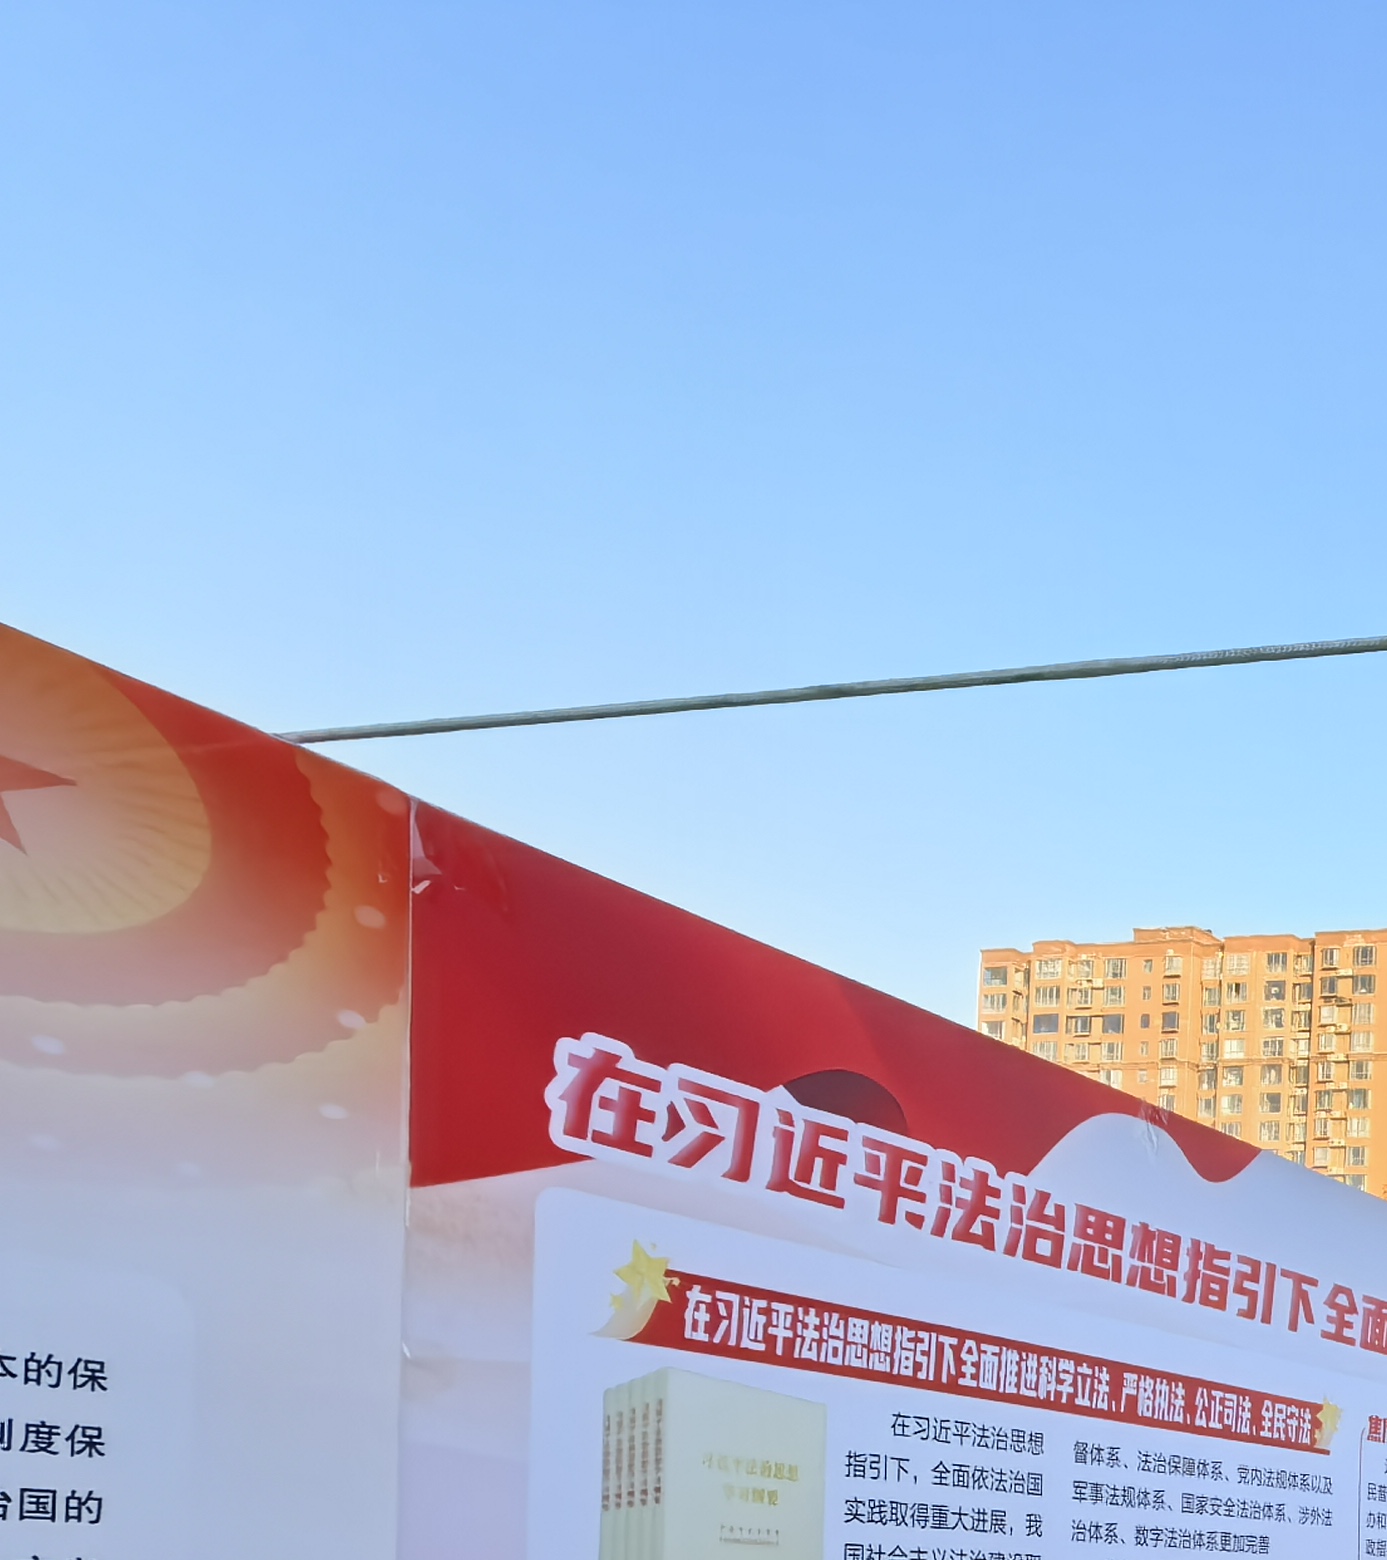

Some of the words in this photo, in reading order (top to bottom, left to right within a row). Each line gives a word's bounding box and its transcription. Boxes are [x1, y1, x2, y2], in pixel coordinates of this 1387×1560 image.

[684, 1286, 1312, 1445] 在习近平法治思想指引下全面推进科学立法、严格执法、公正司法、全民守法
[891, 1412, 1045, 1456] 在习近平法治思想
[845, 1451, 1043, 1497] 指引下，全面依法治国
[1073, 1440, 1333, 1496] 督体系、法治保障体系、党内法规体系以及
[844, 1499, 1043, 1537] 实践取得重大进展，我
[1072, 1480, 1333, 1527] 军事法规体系、国家安全法治体系、涉外法
[1071, 1520, 1271, 1555] 治体系、数字法治体系更加完善
